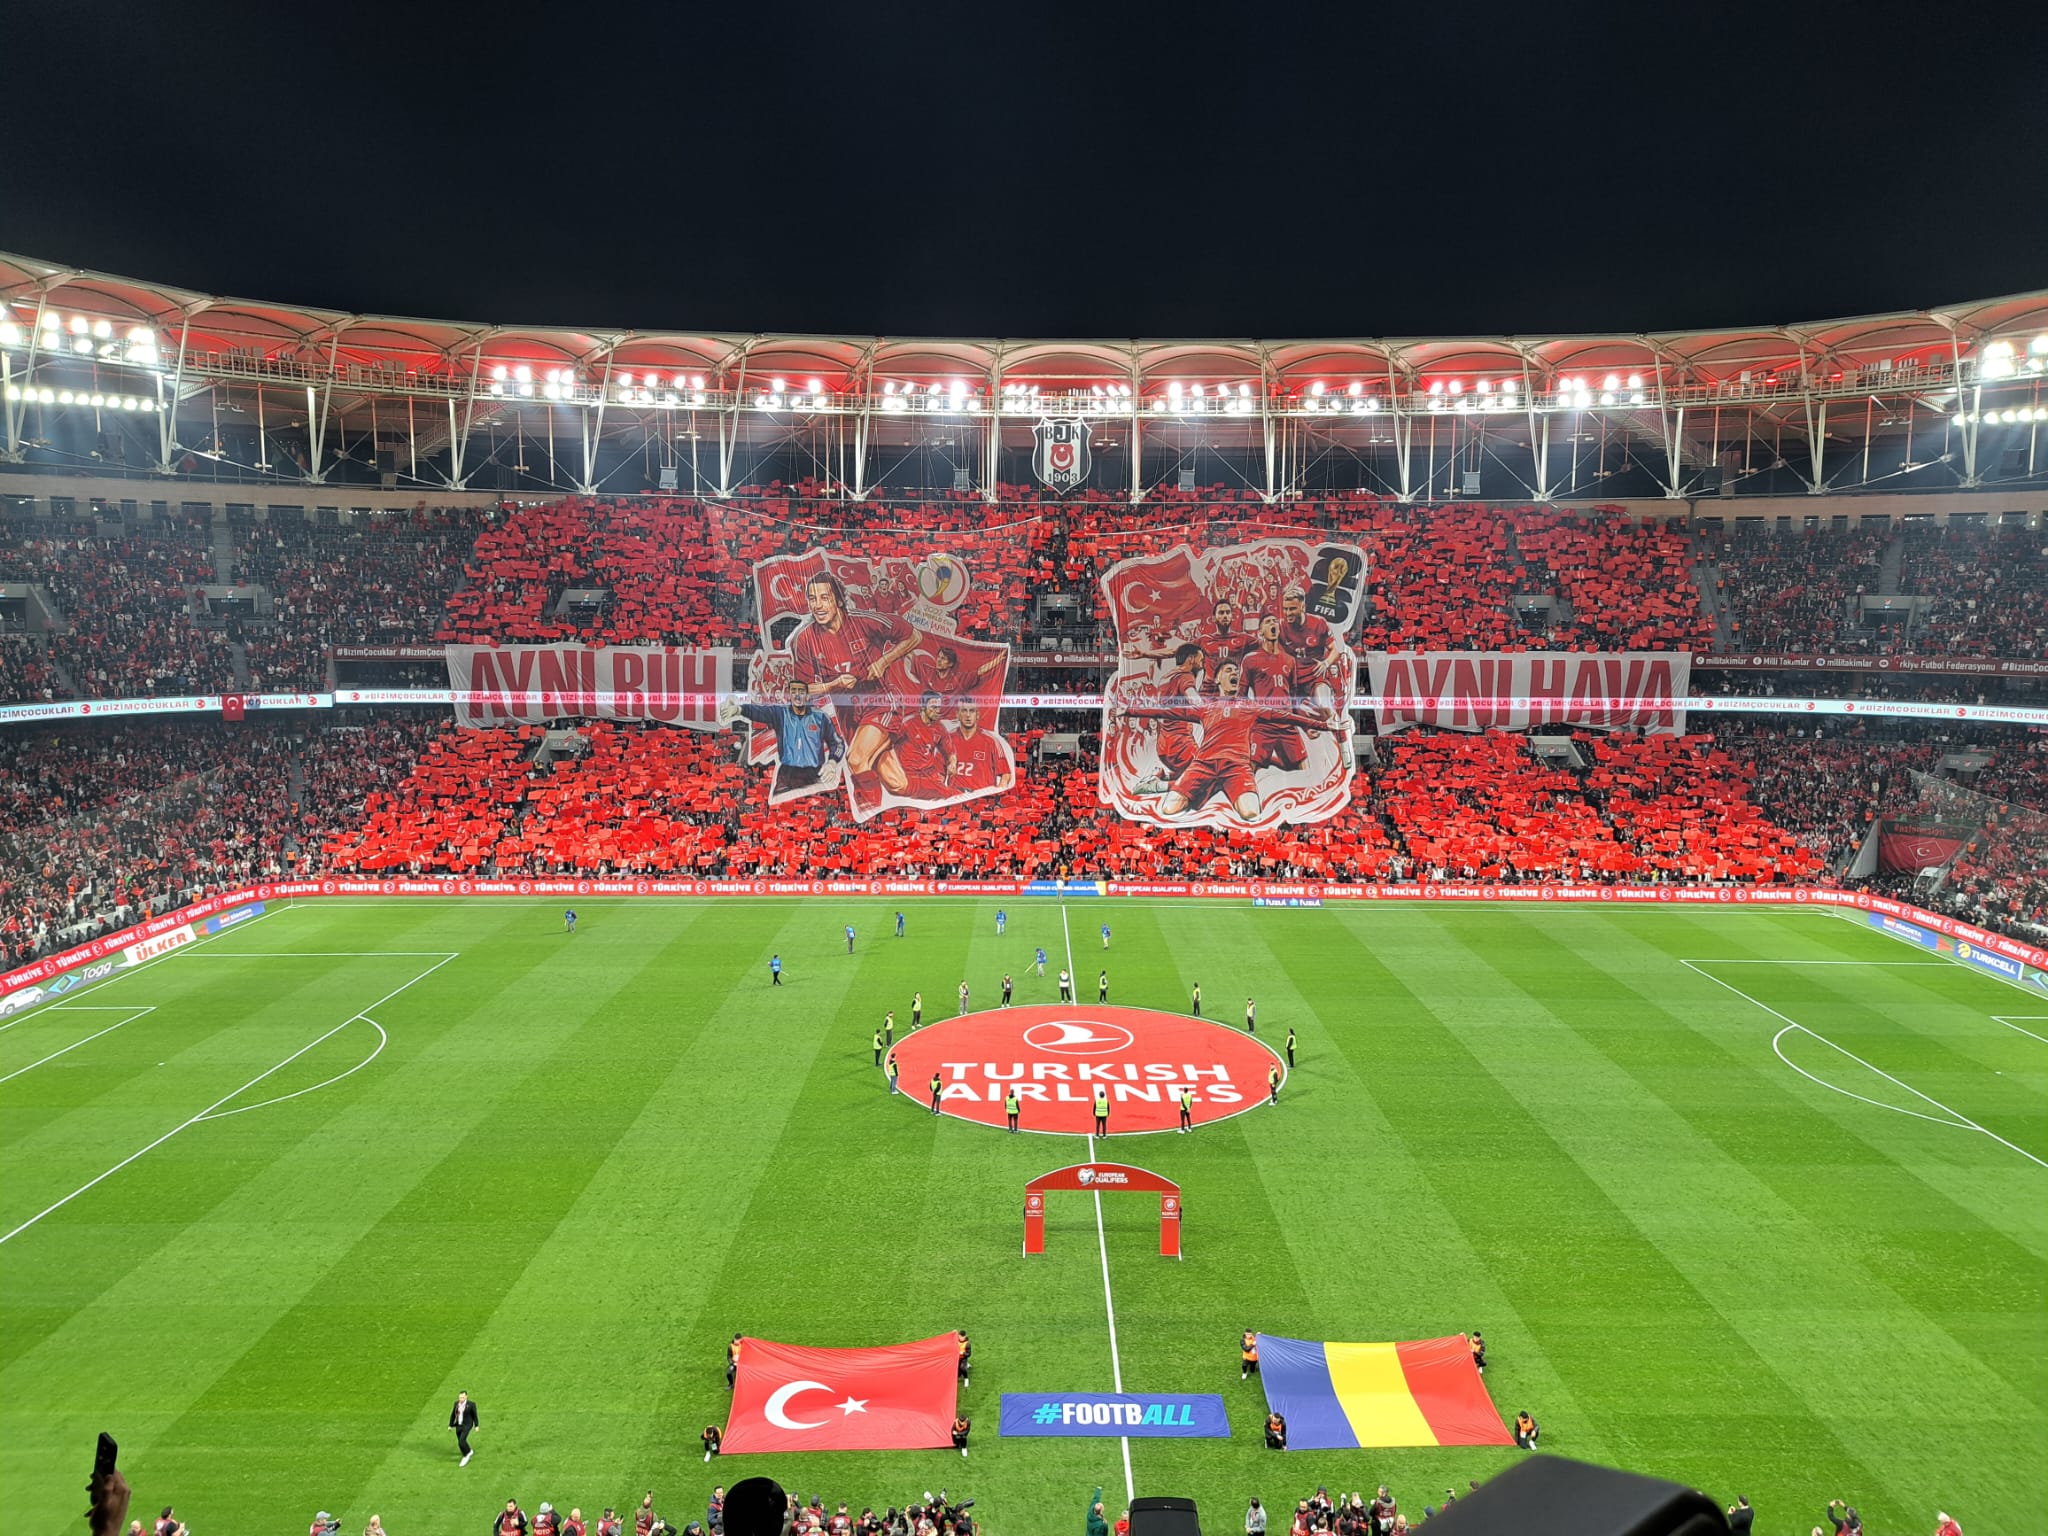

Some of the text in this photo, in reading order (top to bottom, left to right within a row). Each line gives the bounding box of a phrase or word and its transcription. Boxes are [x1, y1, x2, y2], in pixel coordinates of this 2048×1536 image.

[1045, 424, 1080, 440] BJK
[1047, 472, 1079, 483] 1903
[906, 611, 929, 626] KOREA
[1314, 604, 1336, 617] FIFA
[1218, 646, 1229, 658] 10
[1295, 647, 1306, 659] 21
[1920, 660, 1944, 670] Futbol
[1946, 661, 1996, 672] Federasyonu
[467, 649, 717, 722] AYNI RUH
[1272, 674, 1284, 687] 18
[1381, 659, 1675, 727] AYNI HAVA
[1222, 707, 1231, 717] 8
[956, 761, 975, 777] 22
[338, 881, 380, 892] TÜRKİYE
[398, 881, 439, 892] TÜRKİYE
[593, 881, 634, 892] TÜRKİYE
[651, 881, 692, 892] TÜRKİYE
[710, 881, 751, 892] TÜRKİYE
[769, 881, 810, 892] TÜRKİYE
[885, 881, 925, 892] TÜRKİYE
[1206, 883, 1247, 894] TÜRKİYE
[1264, 884, 1305, 895] TÜRKİYE
[1323, 885, 1363, 896] TÜRKİYE
[1381, 885, 1421, 897] TÜRKİYE
[1498, 887, 1538, 897] TÜRKİYE
[1556, 887, 1597, 898] TÜRKİYE
[1615, 888, 1657, 899] TÜRKİYE
[1674, 888, 1716, 899] TÜRKİYE
[1750, 889, 1792, 900] TÜRKİYE
[1912, 910, 1943, 928] TÜRKİYE
[1954, 924, 1985, 943] TÜRKİYE
[5, 890, 255, 989] TÜRKİYE TÜRKİYE TÜRKİYE TÜRKİYE TÜRKİYE TÜRKİYE
[136, 932, 188, 962] ÜLKER
[1971, 949, 2017, 976] TURKCELL
[81, 962, 113, 982] Togg
[941, 1062, 1231, 1081] TURKISH
[940, 1082, 1243, 1102] AIRLINES
[1031, 1402, 1196, 1426] #FOOTBALL
